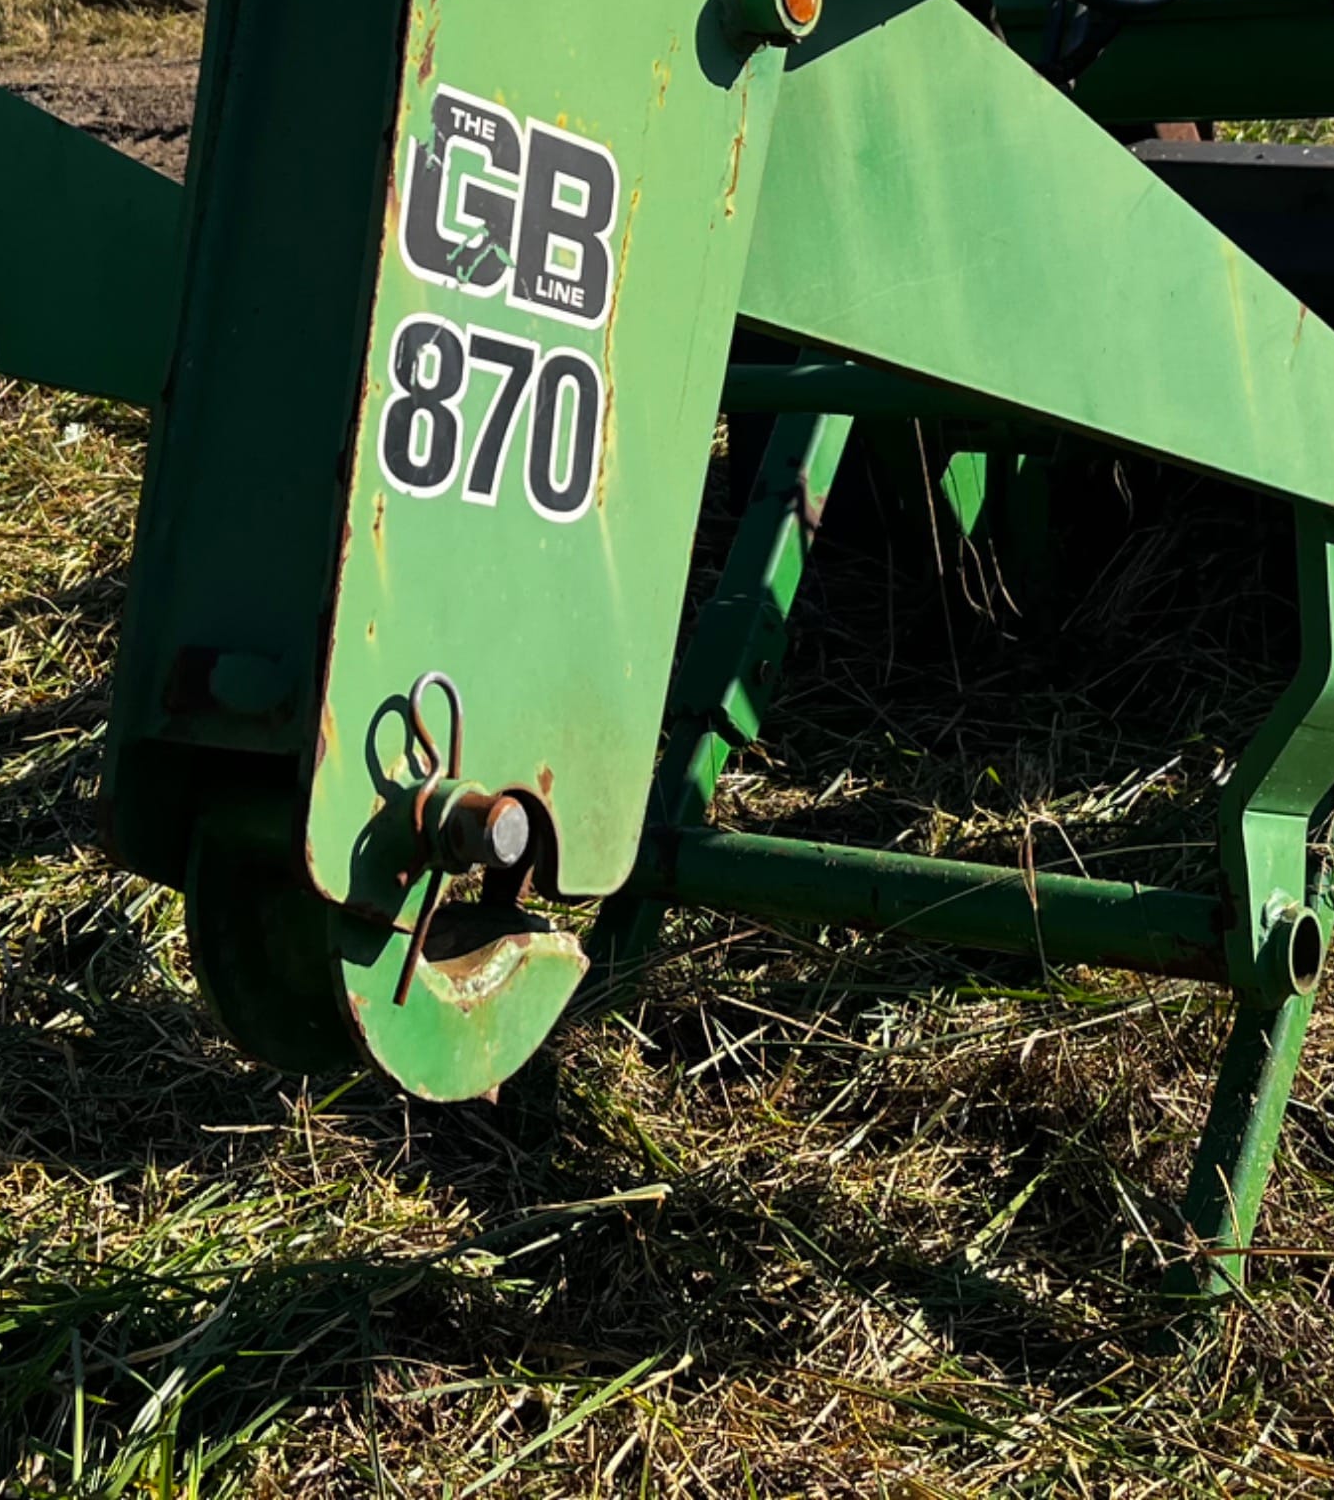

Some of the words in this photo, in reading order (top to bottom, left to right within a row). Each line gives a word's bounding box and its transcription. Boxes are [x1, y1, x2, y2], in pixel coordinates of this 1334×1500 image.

[450, 106, 497, 142] THE
[399, 83, 620, 330] GB
[535, 275, 586, 308] LINE
[377, 312, 605, 523] 870
